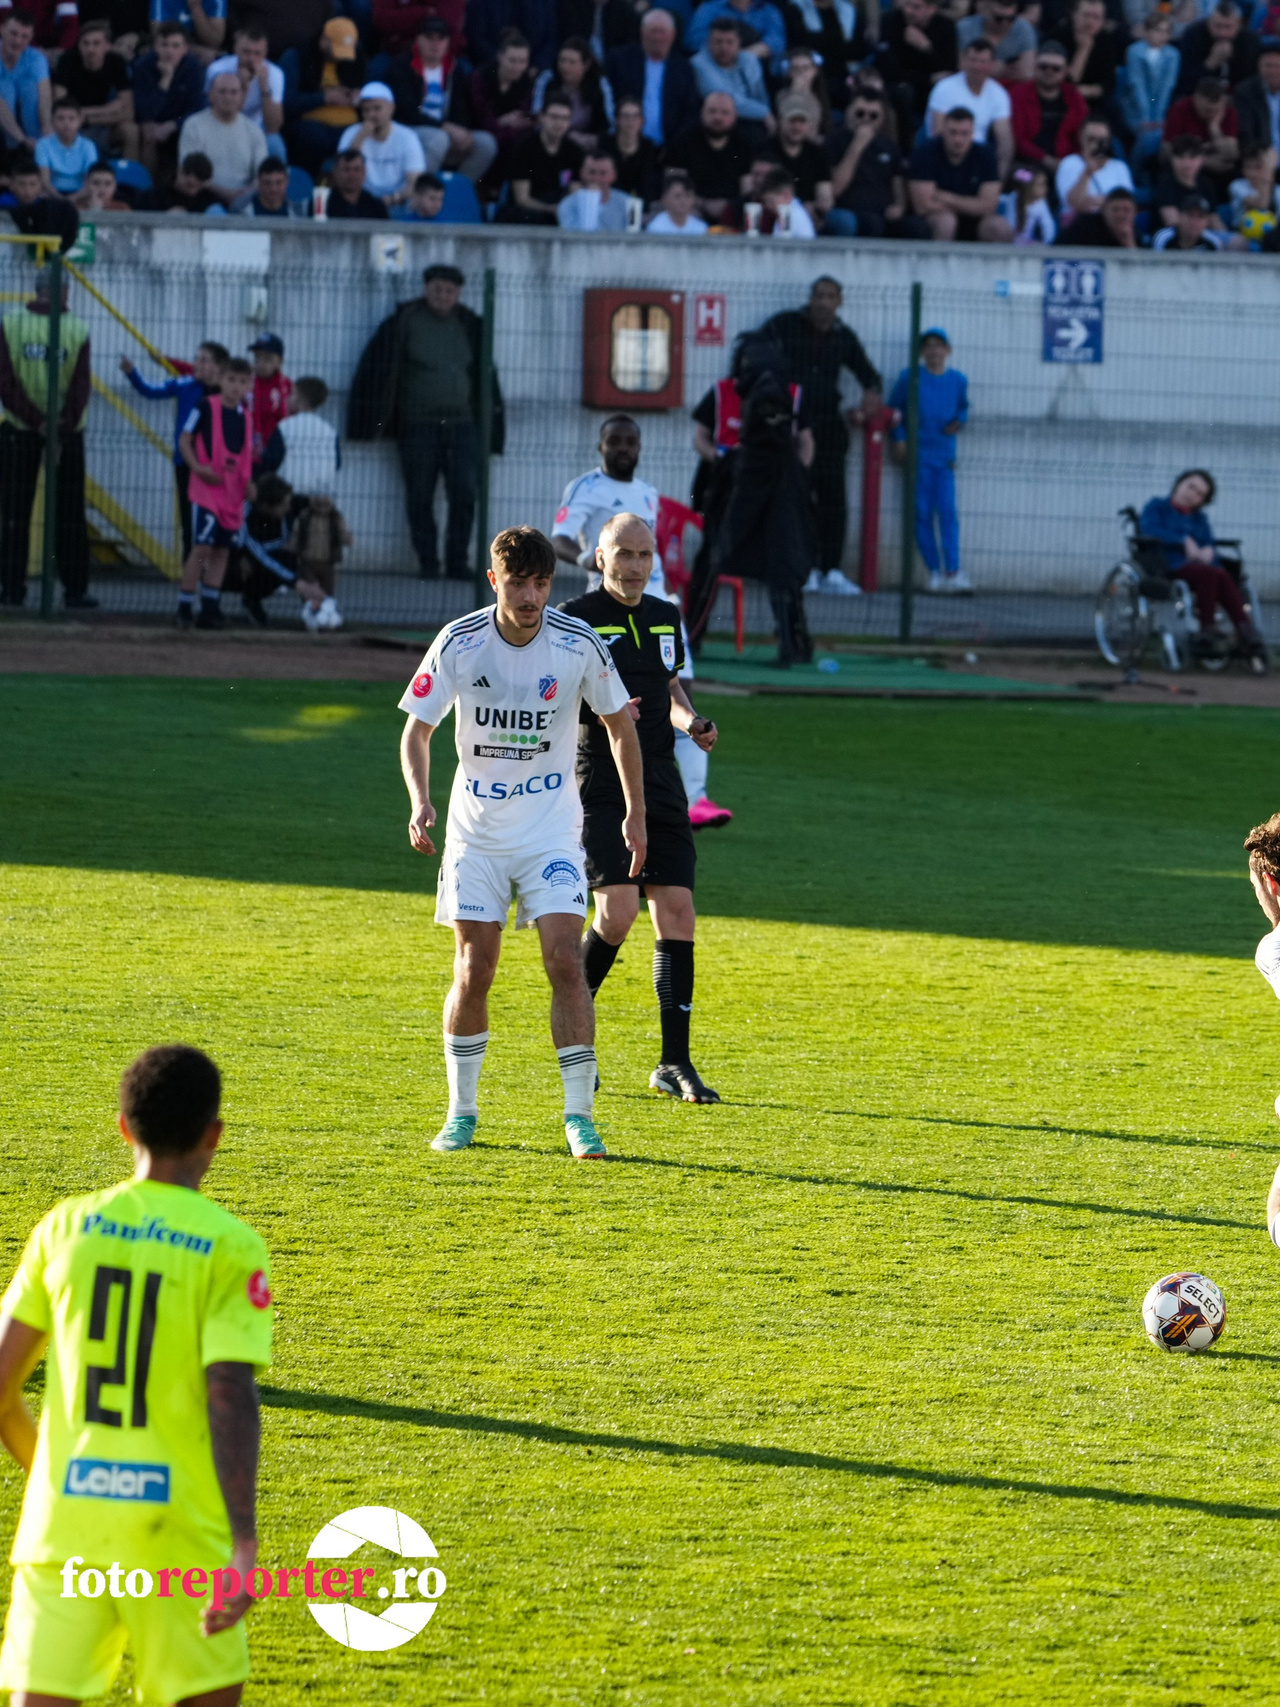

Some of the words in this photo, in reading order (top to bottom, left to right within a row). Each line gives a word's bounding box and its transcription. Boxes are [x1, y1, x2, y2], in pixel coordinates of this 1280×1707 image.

[458, 902, 485, 912] Vestra
[82, 1213, 213, 1255] Panifcom
[1184, 1284, 1220, 1319] SELECT
[85, 1265, 163, 1428] 21
